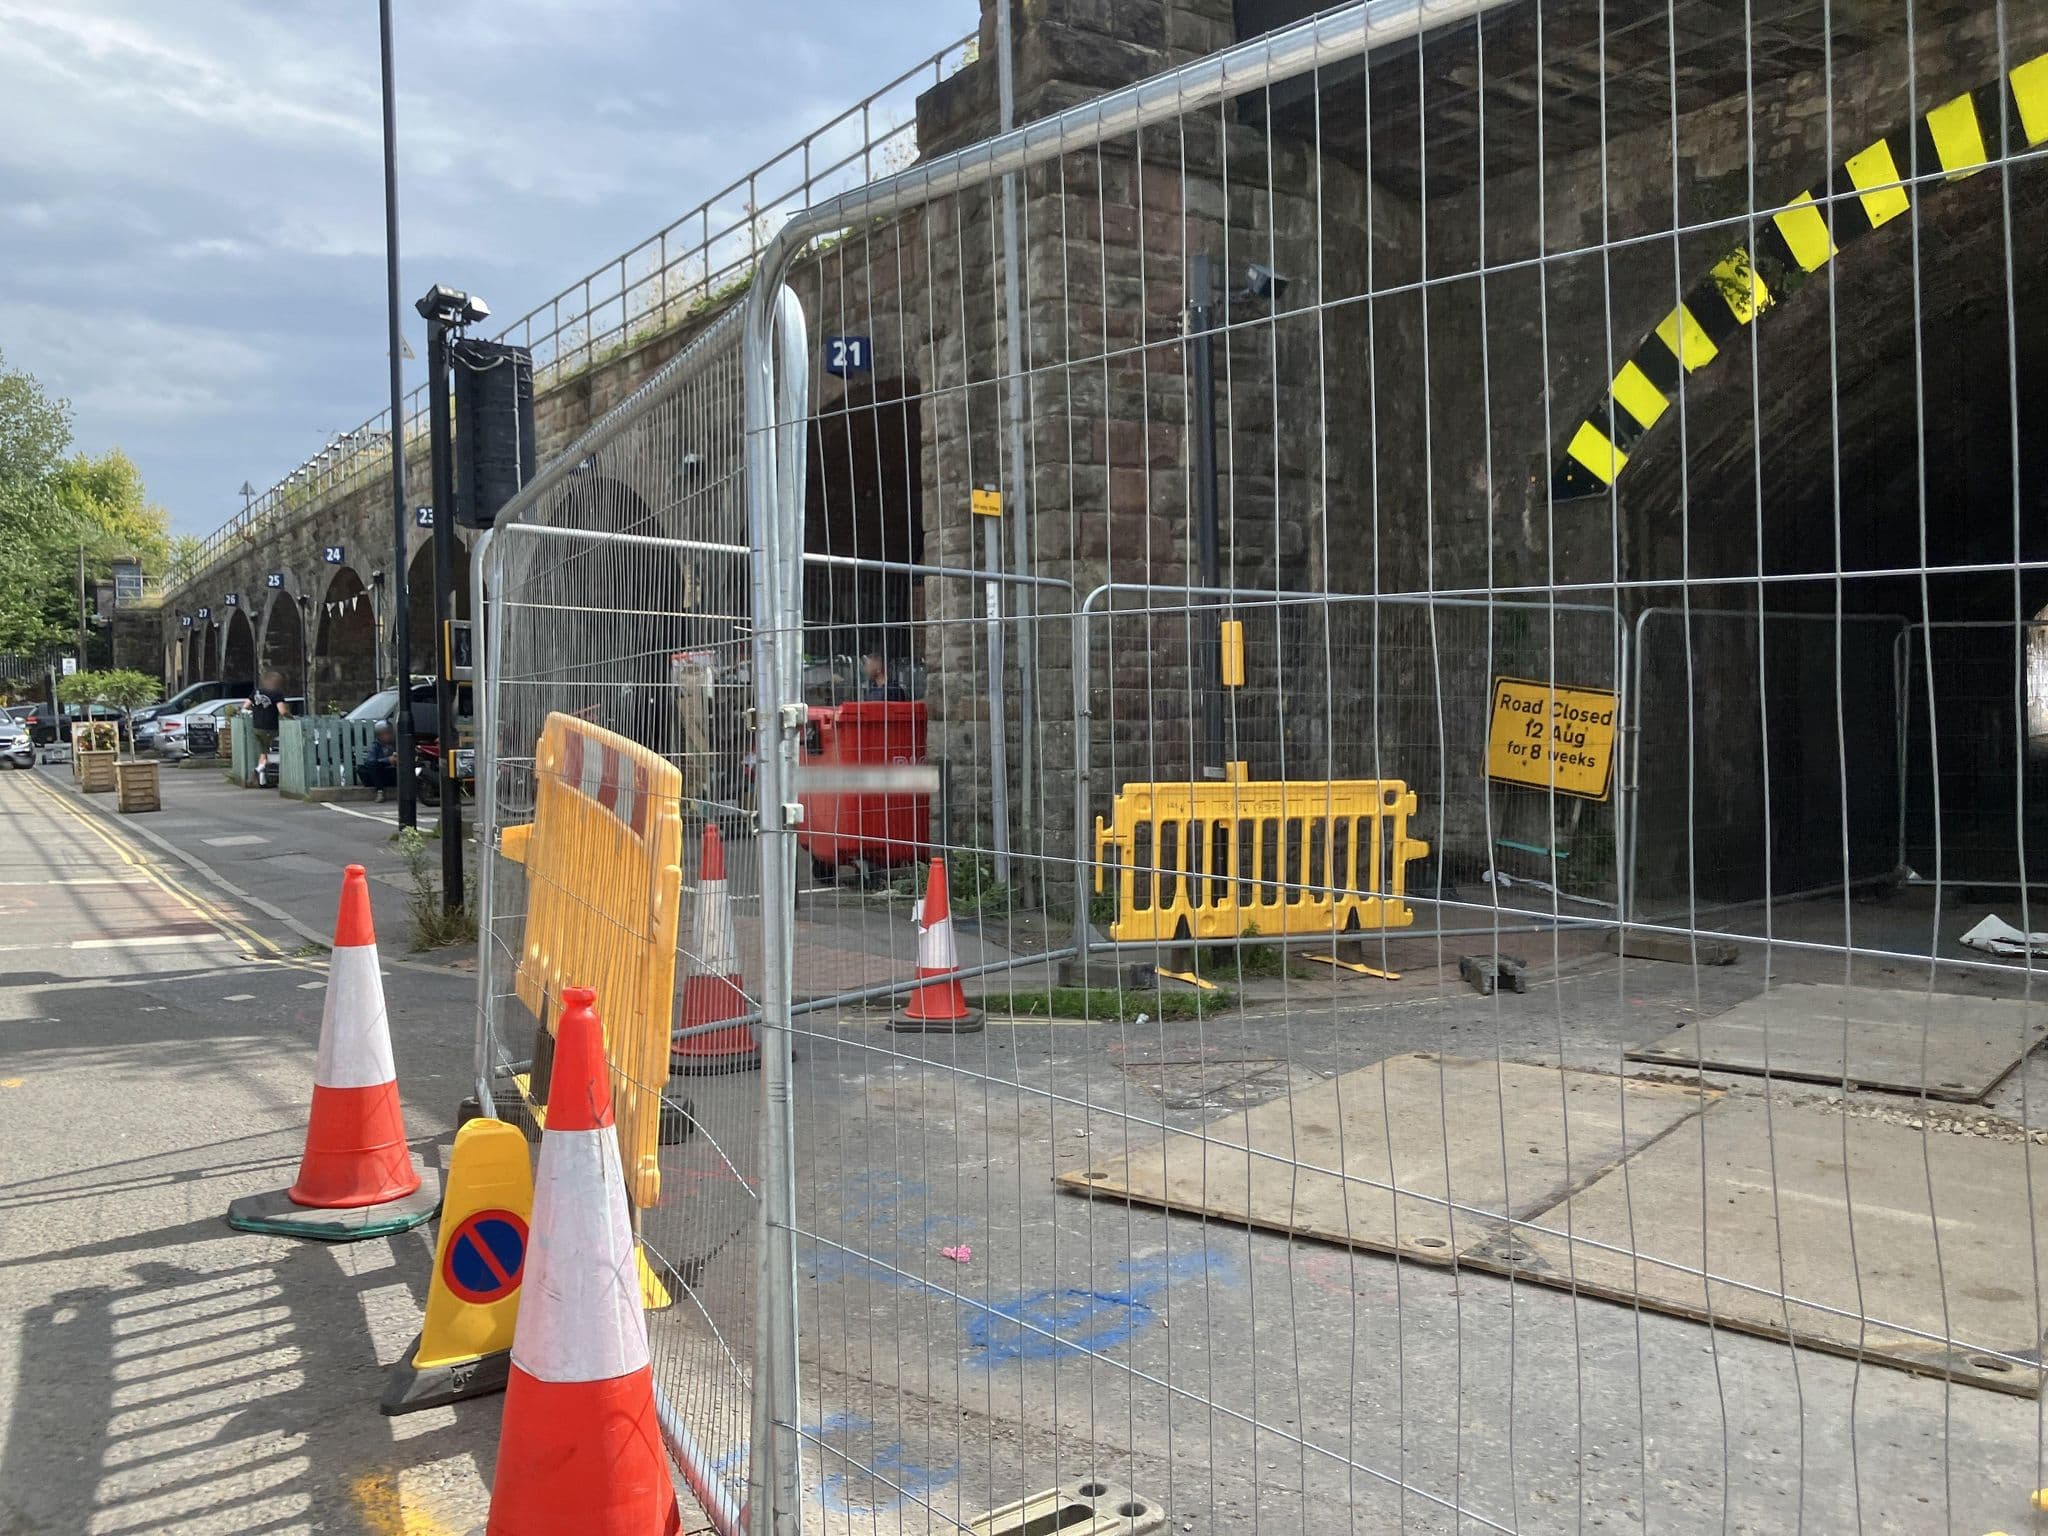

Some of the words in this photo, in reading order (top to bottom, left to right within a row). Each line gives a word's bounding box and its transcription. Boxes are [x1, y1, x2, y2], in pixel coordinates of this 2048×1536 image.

[832, 340, 861, 367] 21
[419, 508, 434, 524] 23
[326, 548, 341, 561] 24
[268, 575, 280, 586] 25
[225, 594, 236, 604] 26
[1500, 694, 1544, 715] Road
[1551, 702, 1613, 726] Closed
[1525, 722, 1544, 738] 12
[1550, 725, 1585, 748] Aug
[1507, 740, 1527, 756] for
[1530, 744, 1542, 760] 8
[1547, 749, 1596, 768] weeks
